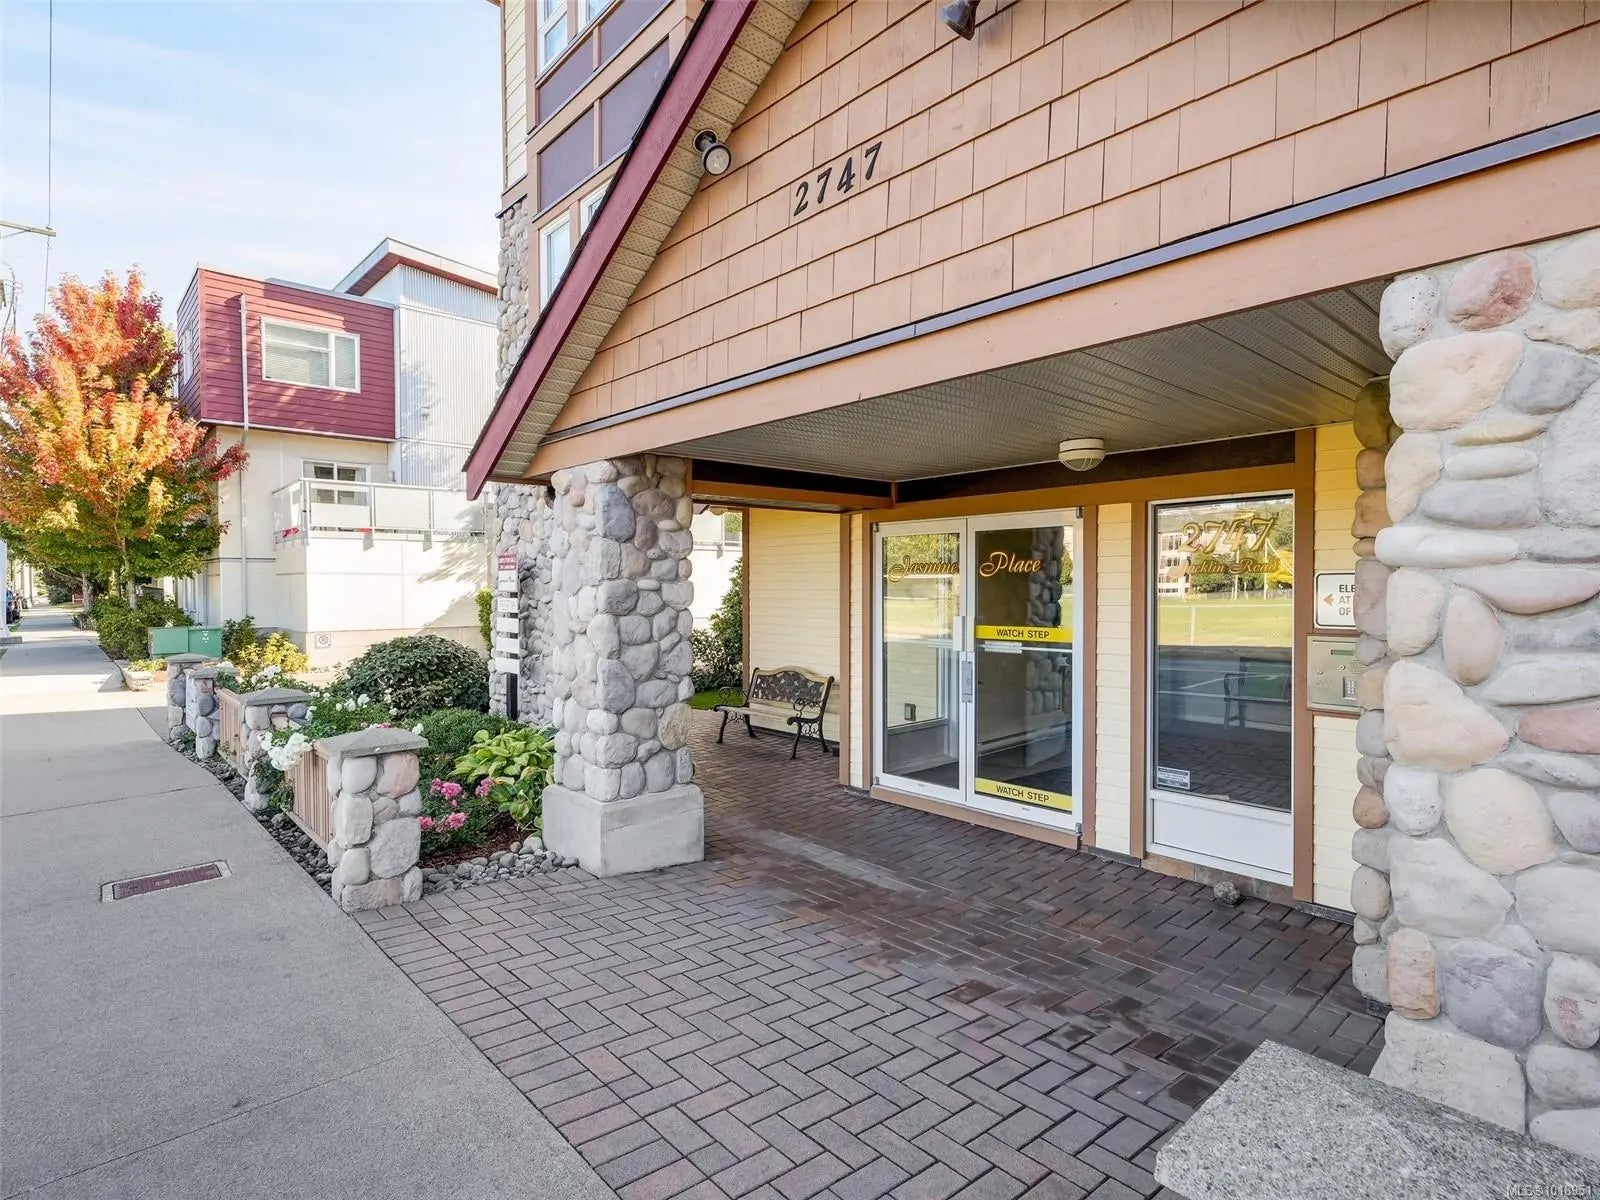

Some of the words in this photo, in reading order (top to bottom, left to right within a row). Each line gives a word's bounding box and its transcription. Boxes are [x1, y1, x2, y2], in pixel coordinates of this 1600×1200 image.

[793, 141, 882, 217] 2747
[1178, 516, 1275, 554] 2747
[888, 555, 959, 583] Jasmine
[979, 551, 1041, 577] Place
[1338, 595, 1352, 605] AT
[996, 629, 1024, 638] WATCH
[1027, 630, 1050, 639] STEP
[995, 784, 1024, 799] WATCH
[1027, 790, 1050, 803] STEP
